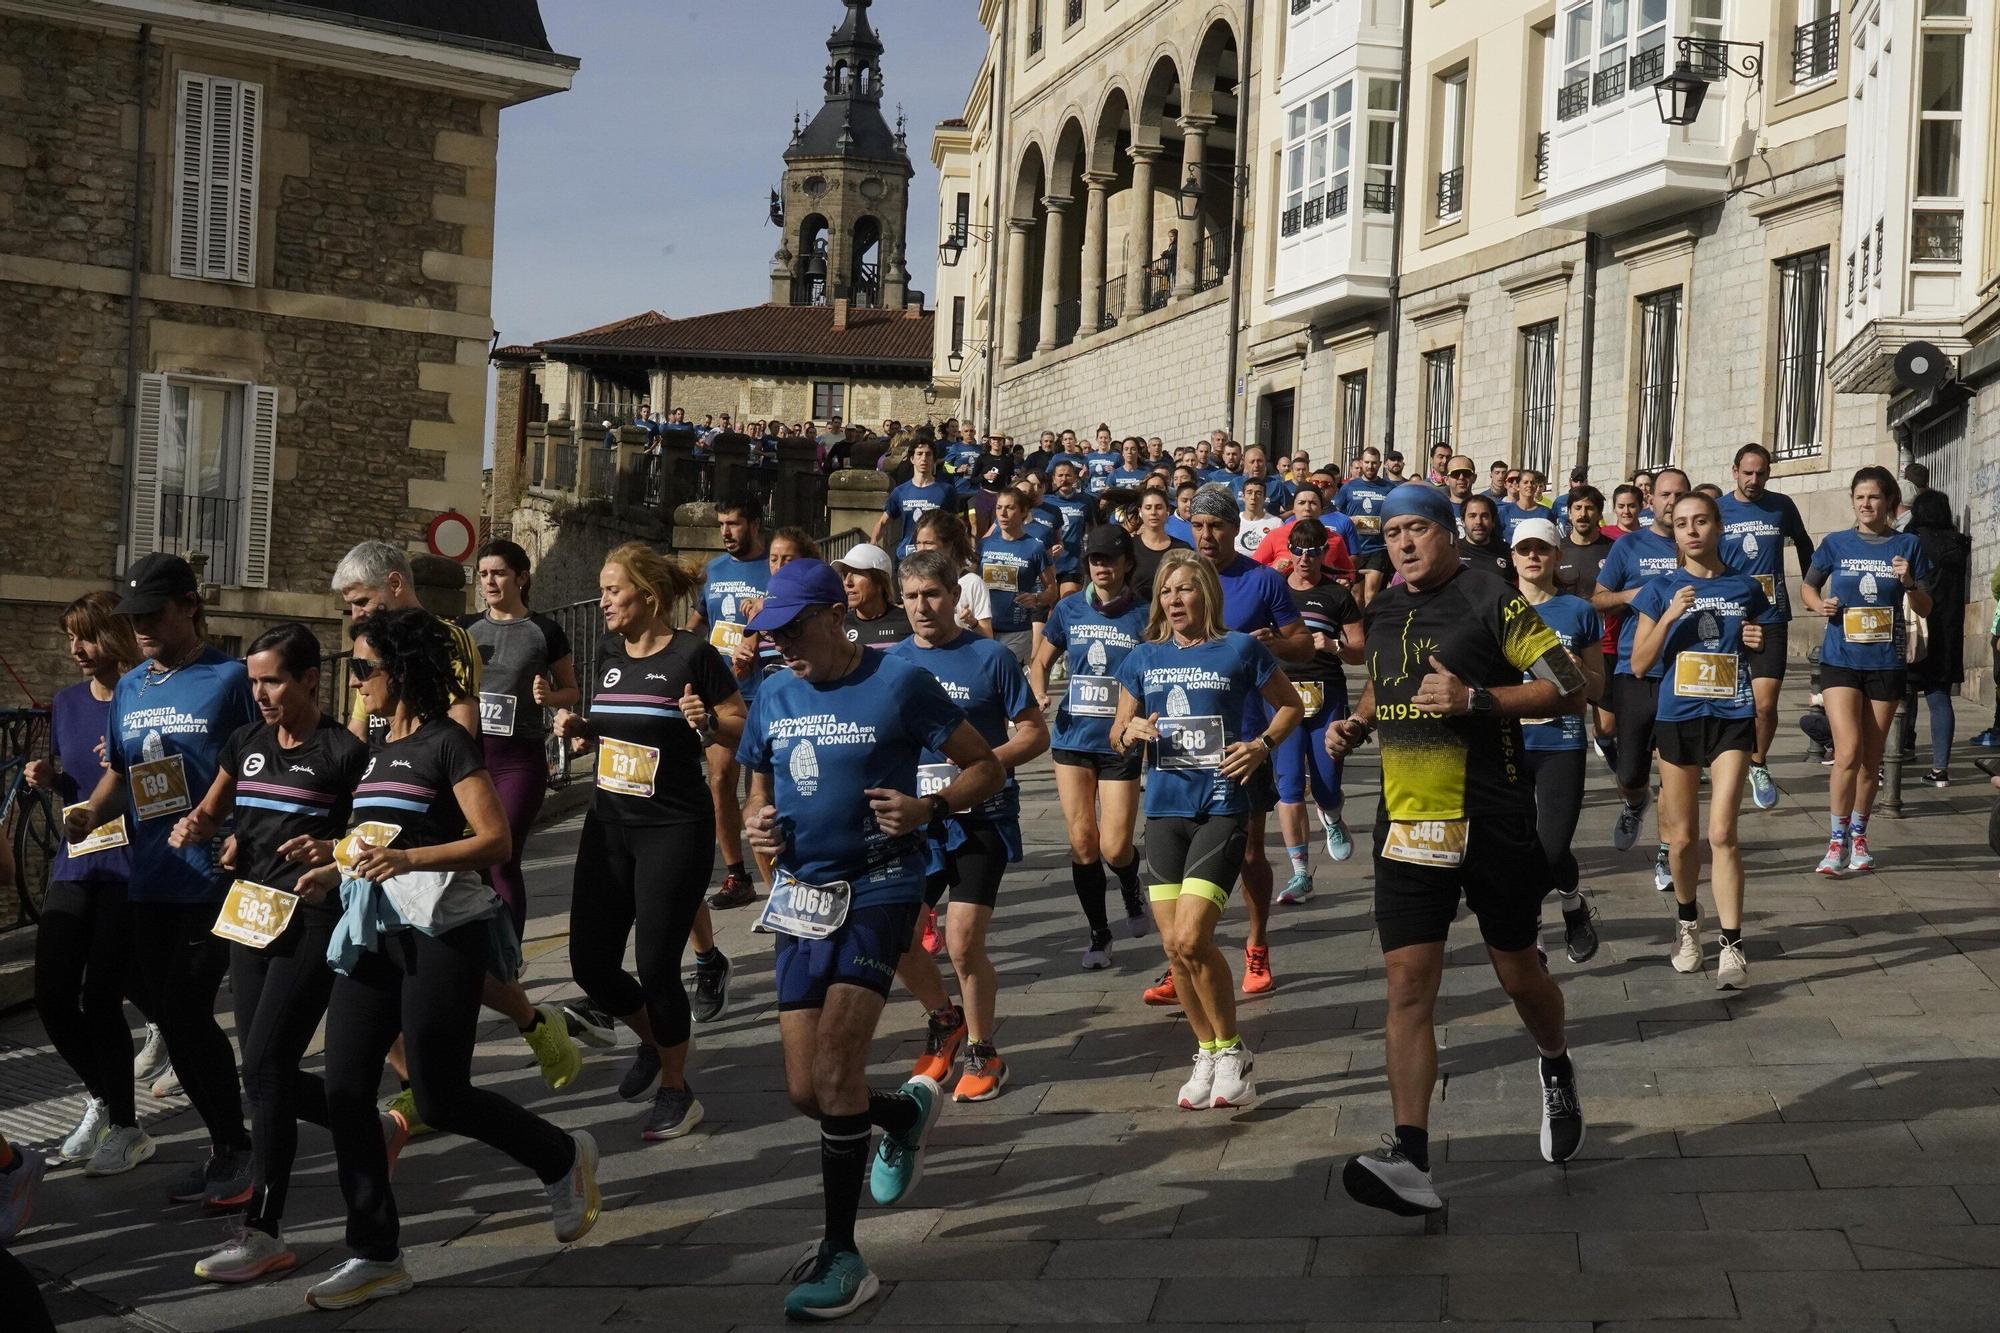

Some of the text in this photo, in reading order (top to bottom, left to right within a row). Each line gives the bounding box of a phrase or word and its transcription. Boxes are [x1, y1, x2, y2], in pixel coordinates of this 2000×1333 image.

[1862, 616, 1877, 629] 96
[1078, 631, 1130, 642] ALMENDRA
[1151, 667, 1202, 675] CONQUISTA
[1152, 671, 1220, 685] ALMENDRA
[1698, 664, 1717, 681] 21
[1187, 681, 1231, 690] KONKISTA
[1080, 686, 1108, 702] 1079
[130, 707, 176, 719] CONQUISTA
[130, 714, 193, 730] ALMENDRA
[162, 725, 208, 734] KONKISTA
[769, 714, 836, 730] LA CONQUISTA
[778, 722, 859, 738] ALMENDRA
[817, 734, 876, 746] KONKISTA
[1172, 730, 1206, 750] 968
[612, 753, 637, 776] 131
[140, 773, 168, 798] 139
[788, 885, 833, 916] 1068
[238, 896, 272, 926] 583
